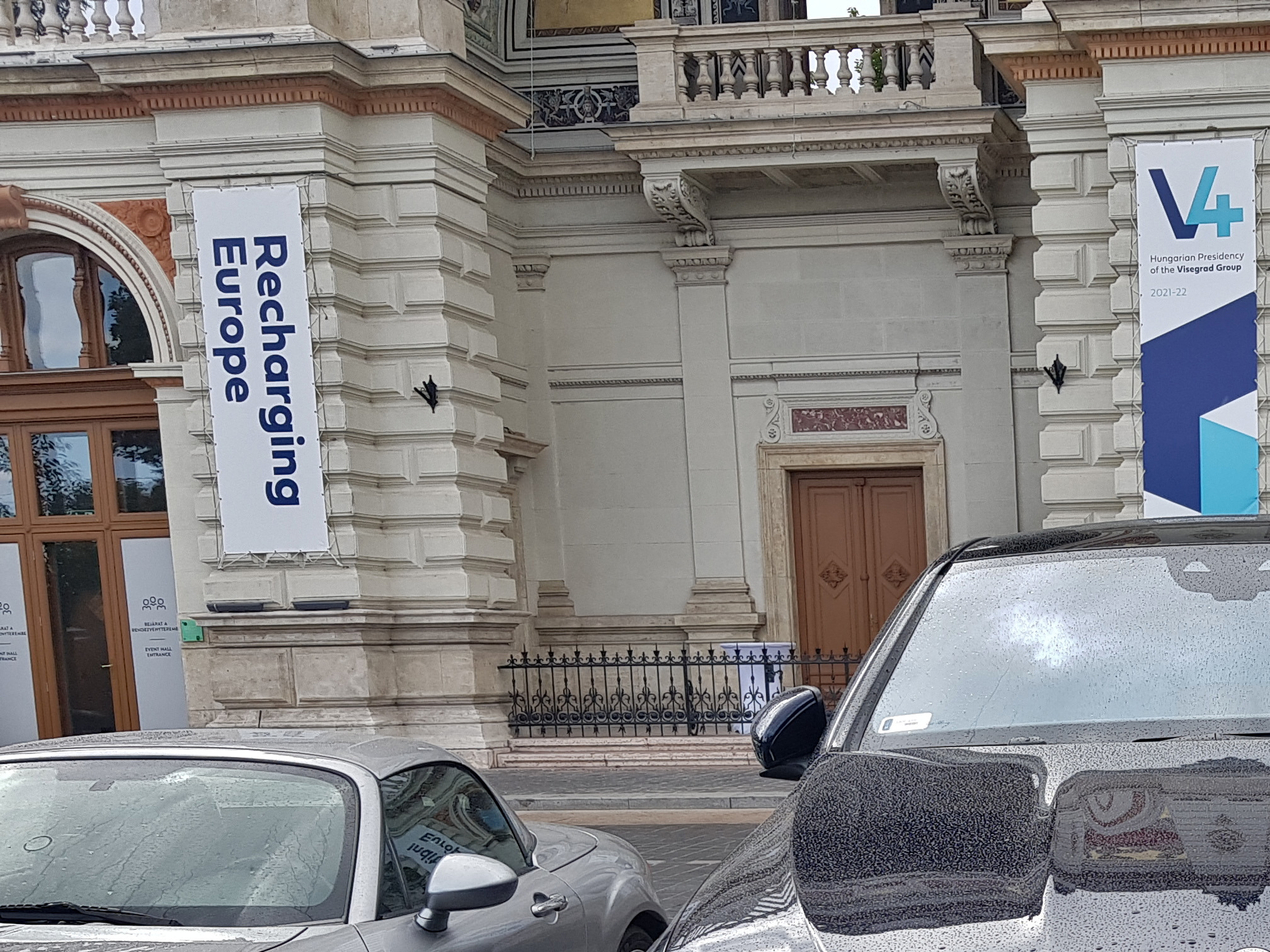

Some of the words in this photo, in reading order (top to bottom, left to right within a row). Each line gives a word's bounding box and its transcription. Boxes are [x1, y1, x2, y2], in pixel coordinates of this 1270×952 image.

[1147, 165, 1244, 240] V4
[1150, 253, 1196, 265] Hungarian
[1197, 251, 1245, 262] Presidency
[1150, 266, 1159, 275] of
[1161, 265, 1175, 274] the
[1176, 264, 1214, 275] Visegrad
[1216, 263, 1242, 273] Group
[1150, 287, 1188, 298] 2021-22
[211, 236, 249, 404] Europe
[253, 234, 306, 507] Recharging
